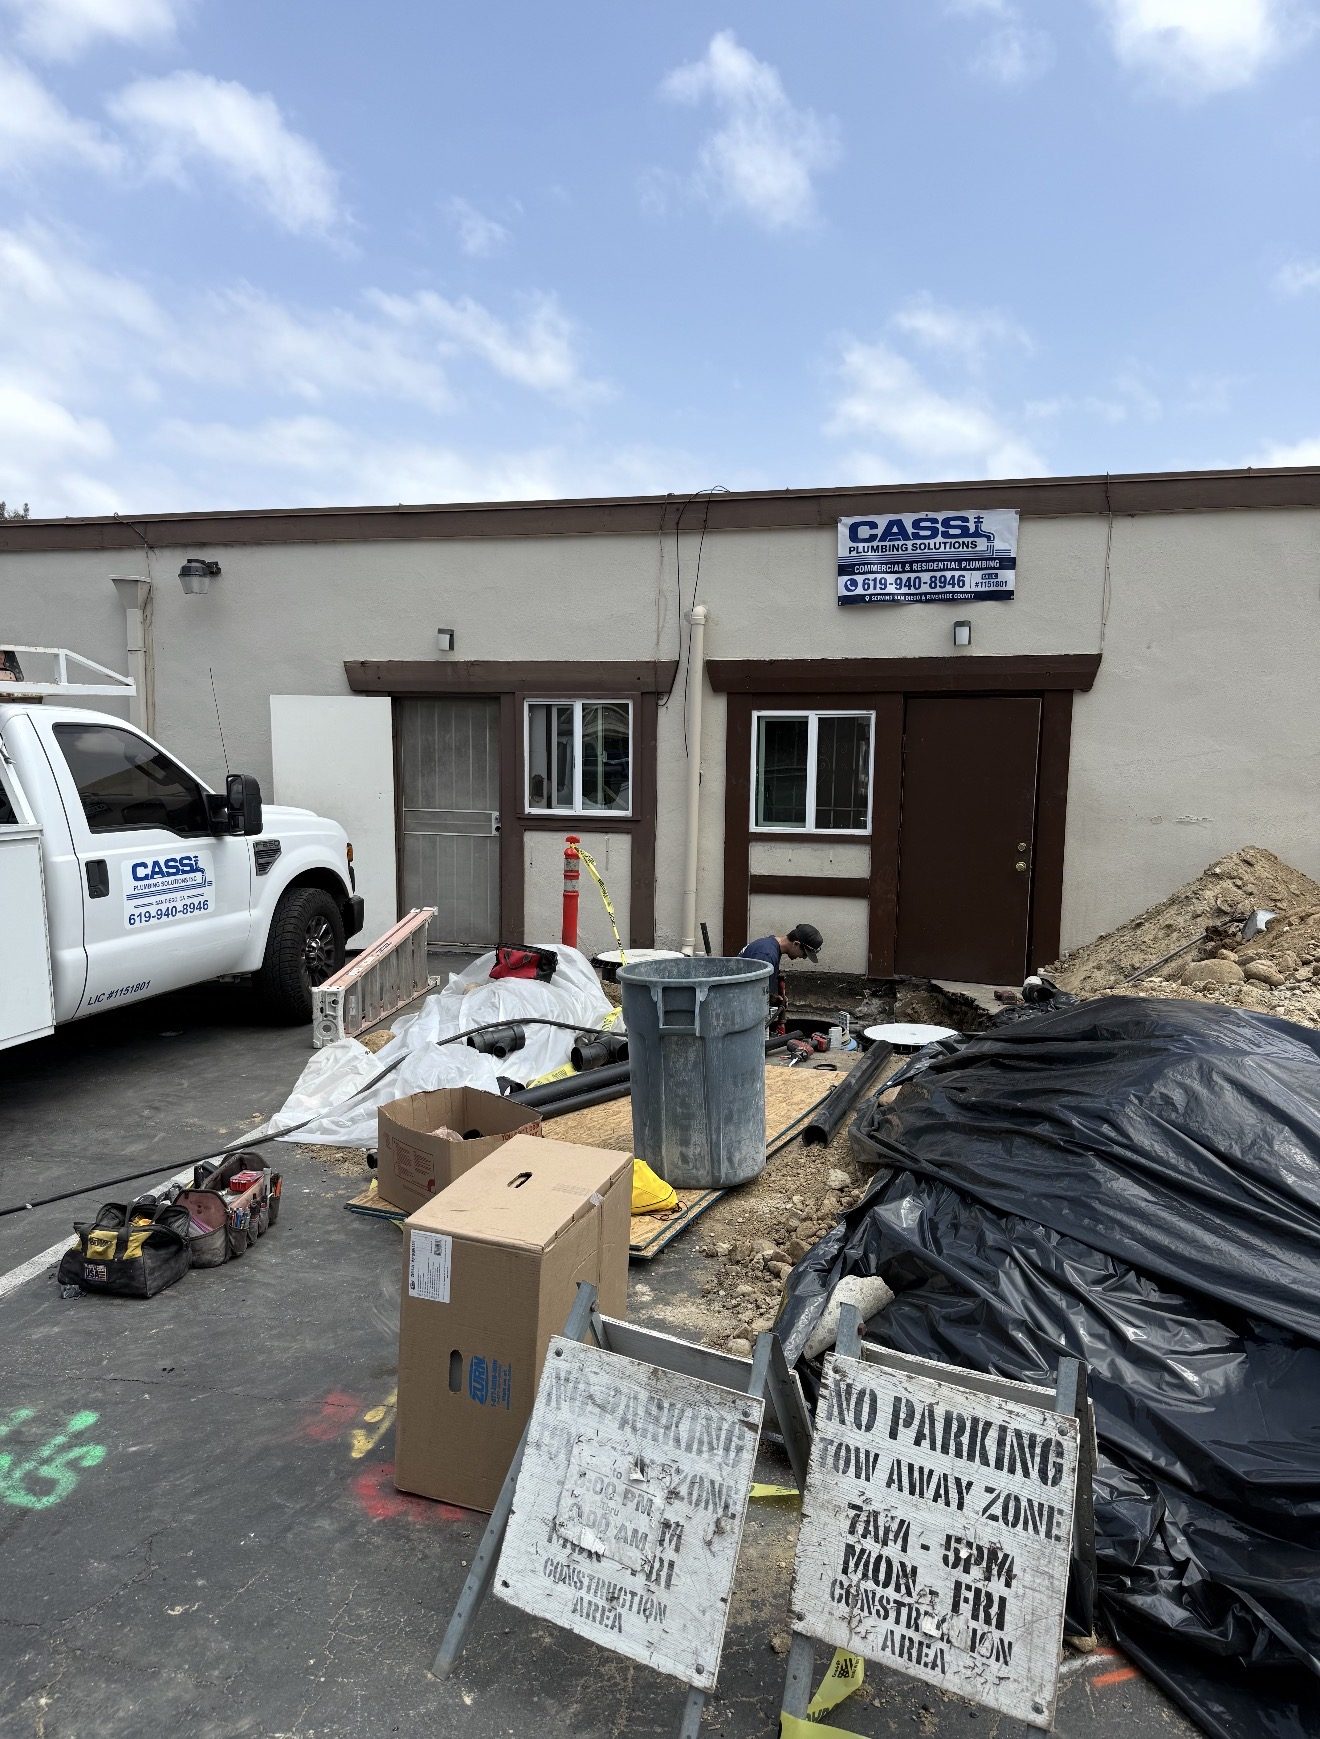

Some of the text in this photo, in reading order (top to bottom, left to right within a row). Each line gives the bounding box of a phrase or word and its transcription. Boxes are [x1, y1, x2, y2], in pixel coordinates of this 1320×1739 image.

[848, 515, 970, 544] CASS
[848, 541, 978, 555] PLUMBING SOLUTIONS
[854, 564, 903, 573] COMMERCIAL
[912, 561, 960, 570] RESIDENTIAL
[961, 560, 1000, 569] PLUMBING
[862, 574, 966, 591] 619-940-8946
[131, 856, 193, 881] CASS
[133, 882, 160, 891] PLUMBING
[161, 877, 188, 887] SOLUTIONS
[128, 899, 209, 926] 619-940-8946
[87, 980, 152, 1006] LIC #1151801
[471, 1355, 486, 1405] ZURN
[825, 1379, 1064, 1487] NO PARKING
[622, 1487, 653, 1516] PM
[818, 1437, 1065, 1542] TOW AWAY ZONE
[614, 1522, 648, 1551] AM
[847, 1503, 911, 1553] 7AM
[943, 1533, 1015, 1589] 5PM
[543, 1557, 667, 1624] CONSTRUCTION
[841, 1542, 918, 1598] MON
[951, 1579, 1007, 1631] FRI
[572, 1595, 622, 1633] AREA
[881, 1628, 946, 1675] AREA
